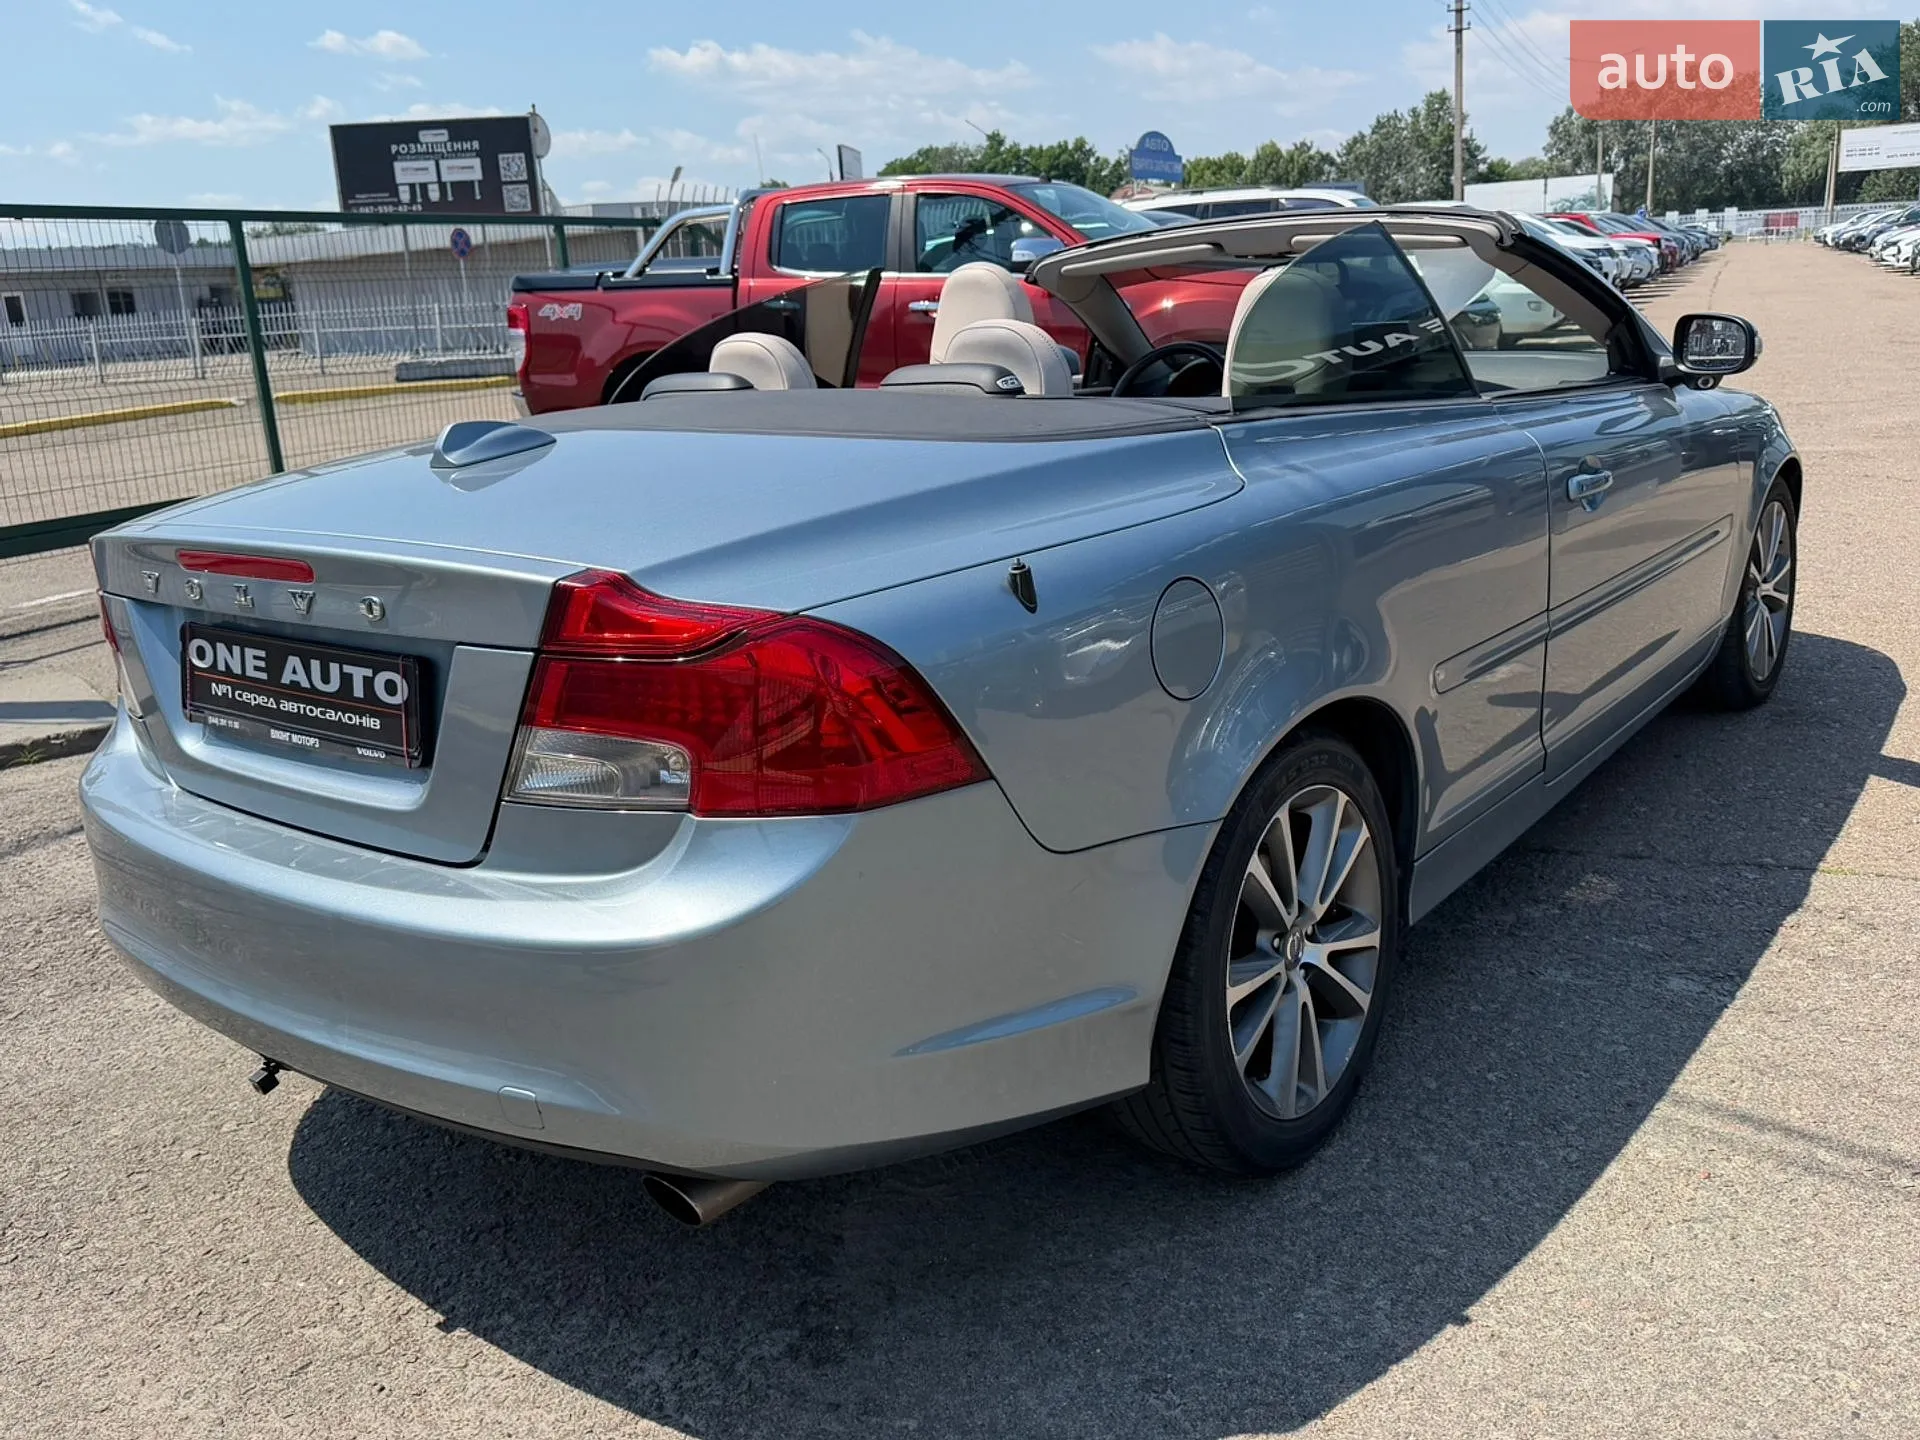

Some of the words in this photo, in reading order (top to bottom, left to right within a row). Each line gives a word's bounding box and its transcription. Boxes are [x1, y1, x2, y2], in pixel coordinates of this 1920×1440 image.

[390, 140, 480, 155] РОЗМІЩЕННЯ
[141, 570, 385, 621] VOLVO
[187, 638, 268, 680] ONE
[280, 655, 409, 705] AUTO
[211, 682, 232, 698] №1
[234, 689, 277, 708] серед
[279, 700, 381, 730] автосалонів
[356, 746, 386, 759] VOLVO
